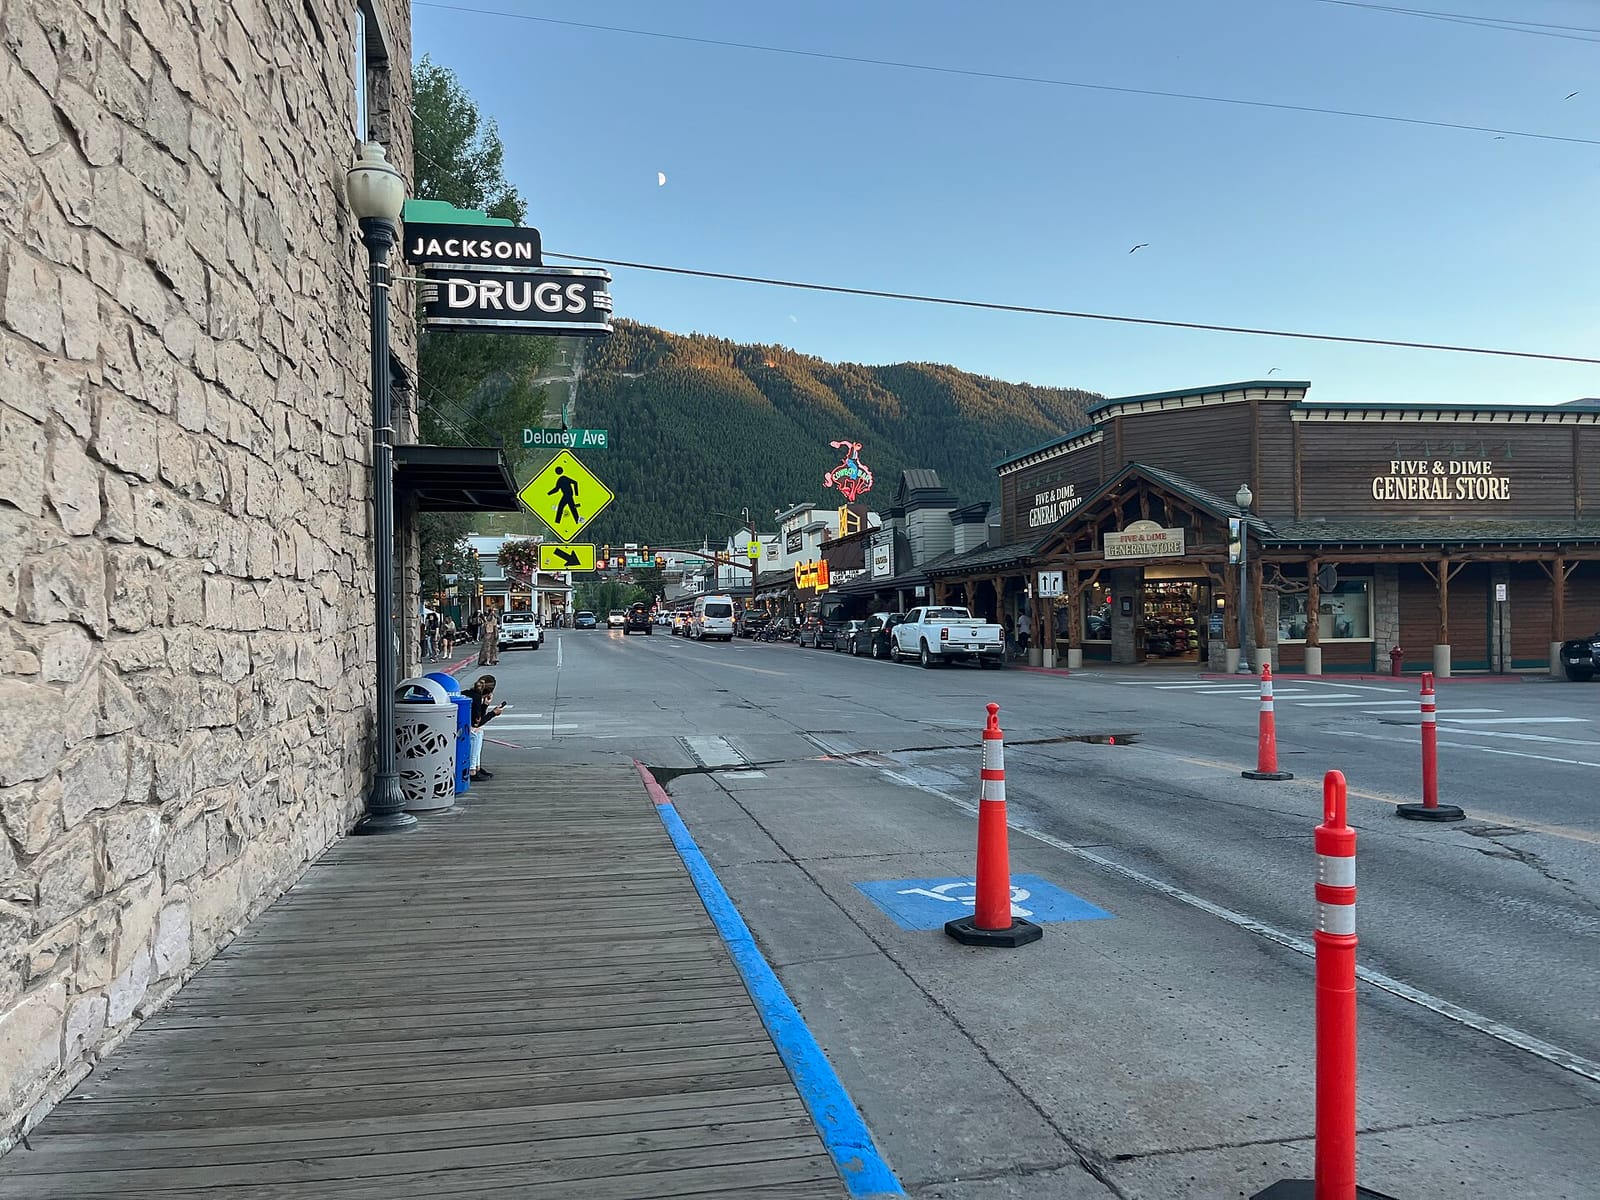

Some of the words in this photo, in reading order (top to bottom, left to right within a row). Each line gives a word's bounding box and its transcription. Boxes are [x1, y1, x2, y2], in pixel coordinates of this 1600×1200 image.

[413, 237, 532, 259] JACKSON
[448, 278, 586, 314] DRUGS
[523, 428, 577, 448] Deloney
[582, 429, 605, 446] Ave
[1390, 460, 1428, 475] FIVE
[1432, 460, 1445, 475] &
[1449, 460, 1493, 475] DIME
[1035, 491, 1050, 506] FIVE
[1050, 490, 1056, 502] &
[1056, 484, 1075, 501] DIME
[1372, 477, 1453, 500] GENERAL
[1455, 477, 1511, 500] STORE
[1029, 503, 1058, 528] GENERAL
[1120, 534, 1138, 543] FIVE
[1138, 534, 1145, 542] &
[1146, 532, 1167, 541] DIME
[1108, 543, 1150, 557] GENERAL
[1150, 541, 1181, 554] STORE
